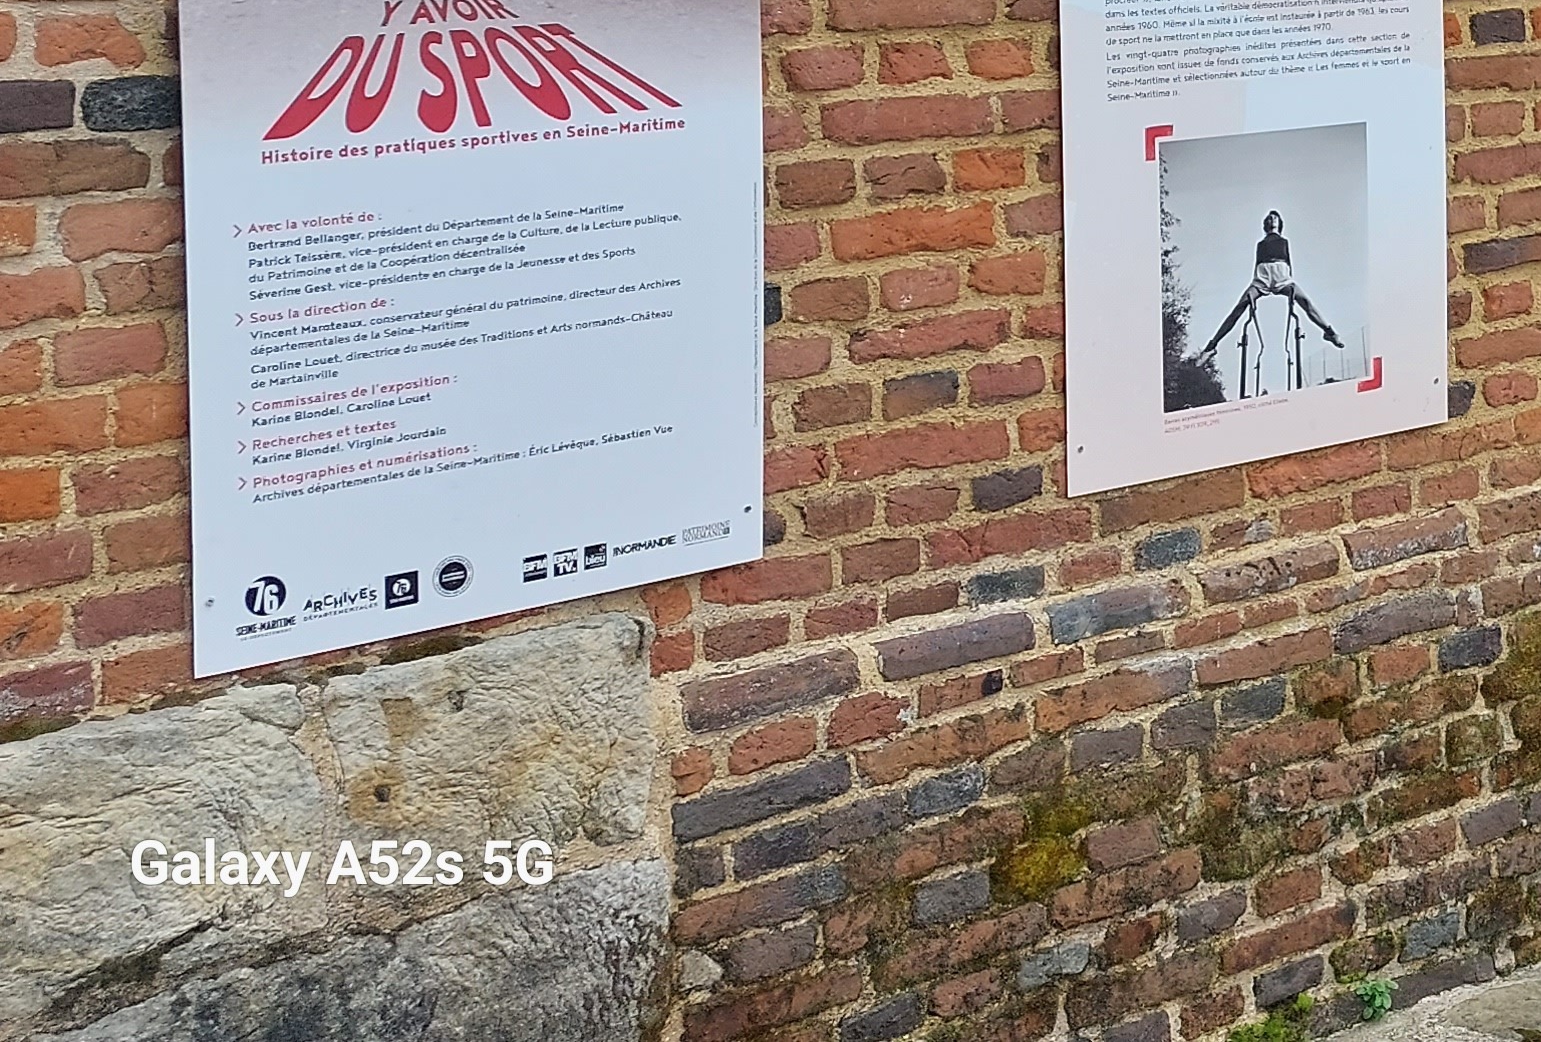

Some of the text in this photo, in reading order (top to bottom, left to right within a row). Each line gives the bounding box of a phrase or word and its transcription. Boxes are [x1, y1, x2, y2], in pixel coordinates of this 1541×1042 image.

[380, 0, 403, 27] Y
[262, 23, 682, 141] DU SPORT
[262, 118, 684, 163] Histoire des pratiques sportives en Seine-Maritime
[247, 211, 374, 233] Avec la volonté de
[248, 238, 300, 251] Bertrand
[368, 225, 421, 239] président
[425, 223, 438, 232] du
[443, 215, 513, 230] Département
[517, 213, 529, 222] de
[533, 212, 541, 220] la
[545, 205, 623, 219] Seine-Maritime
[248, 255, 290, 268] Patrick
[350, 240, 431, 256] vice-président
[452, 235, 488, 245] charge
[492, 232, 504, 241] de
[508, 230, 516, 239] la
[565, 225, 578, 233] de
[581, 222, 589, 231] la
[593, 219, 631, 230] Lecture
[249, 287, 300, 300] Séverine
[432, 270, 445, 278] en
[449, 266, 485, 276] charge
[489, 263, 501, 271] de
[505, 261, 513, 269] la
[518, 257, 565, 268] Jeunesse
[568, 253, 578, 262] et
[582, 252, 599, 260] des
[602, 247, 635, 259] Sports
[250, 326, 296, 339] Vincent
[370, 310, 442, 325] conservateur
[446, 302, 486, 318] général
[489, 301, 502, 309] du
[569, 288, 615, 299] directeur
[618, 284, 635, 293] des
[639, 279, 680, 289] Archives
[250, 298, 386, 323] Sous la direction de
[251, 360, 301, 374] Caroline
[346, 347, 400, 361] directrice
[404, 344, 417, 353] du
[421, 338, 455, 350] musée
[460, 337, 477, 345] des
[482, 329, 533, 342] Traditions
[537, 326, 547, 334] et
[550, 323, 571, 332] Arts
[251, 376, 449, 411] Commissaires de l'exposition
[252, 421, 394, 449] Recherches et textes
[253, 488, 303, 502] Archives
[306, 471, 404, 490] départementales
[408, 468, 420, 476] de
[424, 466, 433, 474] la
[436, 449, 520, 470] Seine-Maritime
[529, 446, 548, 456] Éric
[601, 430, 650, 443] Sébastien
[654, 425, 672, 433] Vue
[253, 446, 469, 487] Photographies et numérisations
[247, 580, 280, 615] 76
